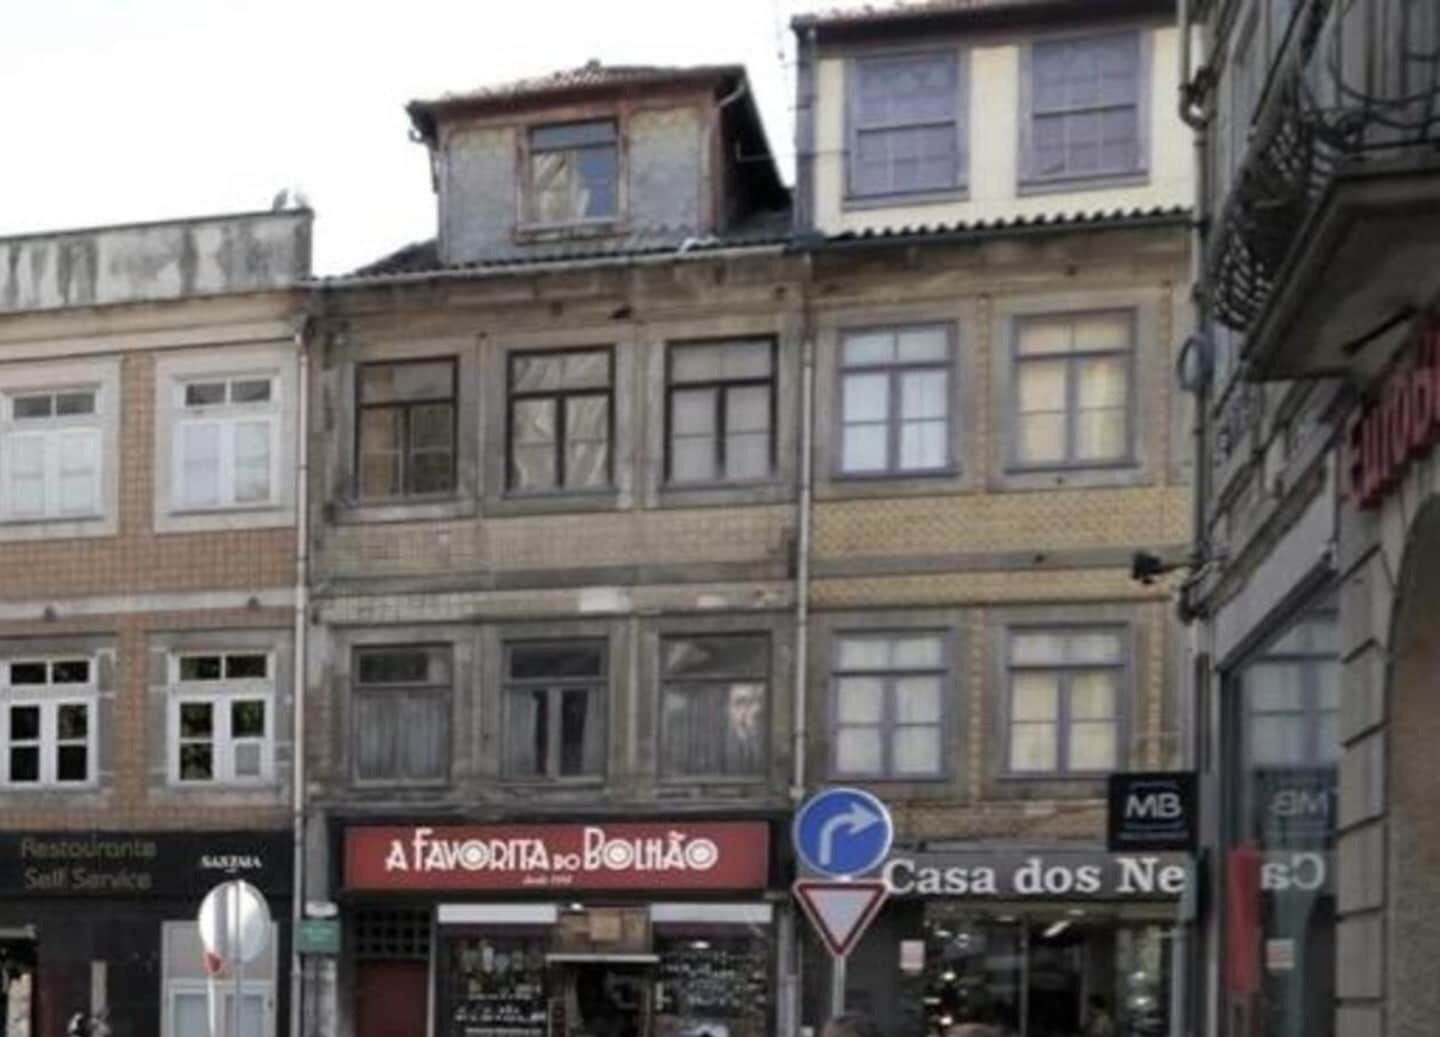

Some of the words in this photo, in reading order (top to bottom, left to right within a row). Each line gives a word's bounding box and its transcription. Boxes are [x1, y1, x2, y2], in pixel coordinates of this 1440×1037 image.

[1125, 793, 1183, 818] MB
[21, 836, 158, 860] Restaurante
[385, 839, 408, 872] A
[24, 867, 67, 890] Self
[71, 867, 153, 890] Service
[882, 857, 997, 894] Casa
[1014, 856, 1102, 893] dos
[1116, 857, 1186, 893] Ne
